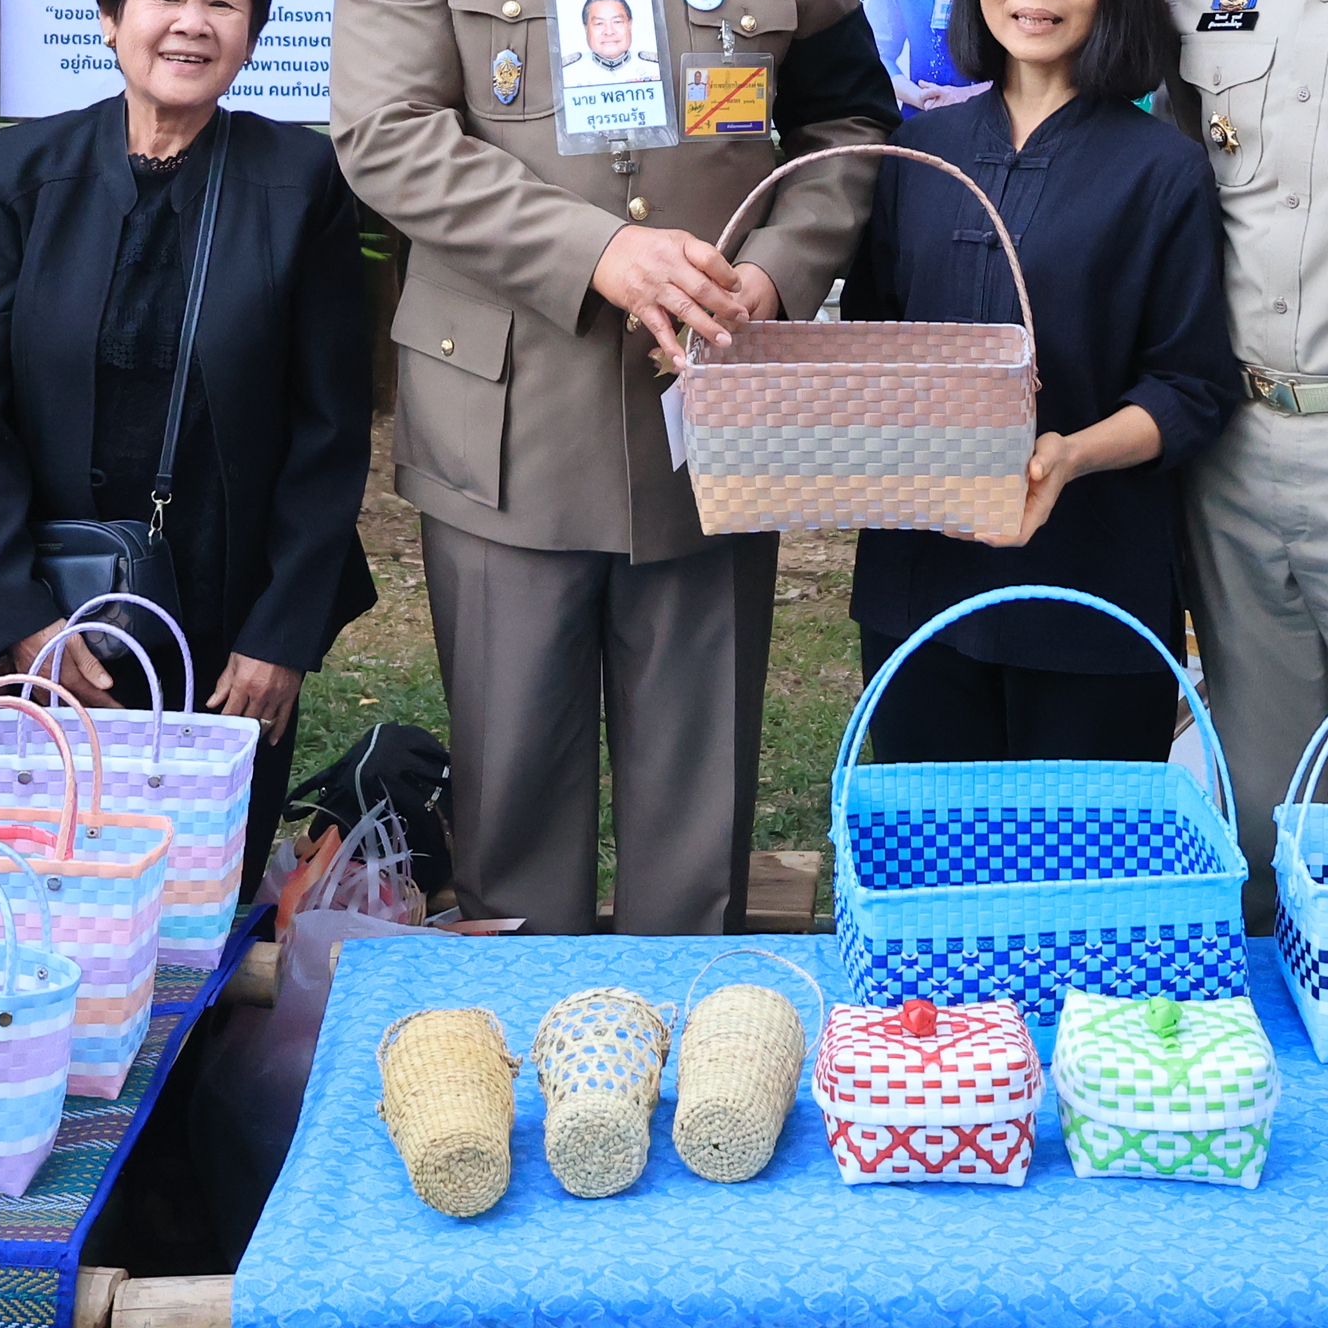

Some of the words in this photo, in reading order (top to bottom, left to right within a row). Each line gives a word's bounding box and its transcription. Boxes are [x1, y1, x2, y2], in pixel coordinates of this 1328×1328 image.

[572, 94, 597, 107] นาย
[601, 88, 654, 104] พลากร
[587, 107, 646, 130] สุวรรณรัฐ
